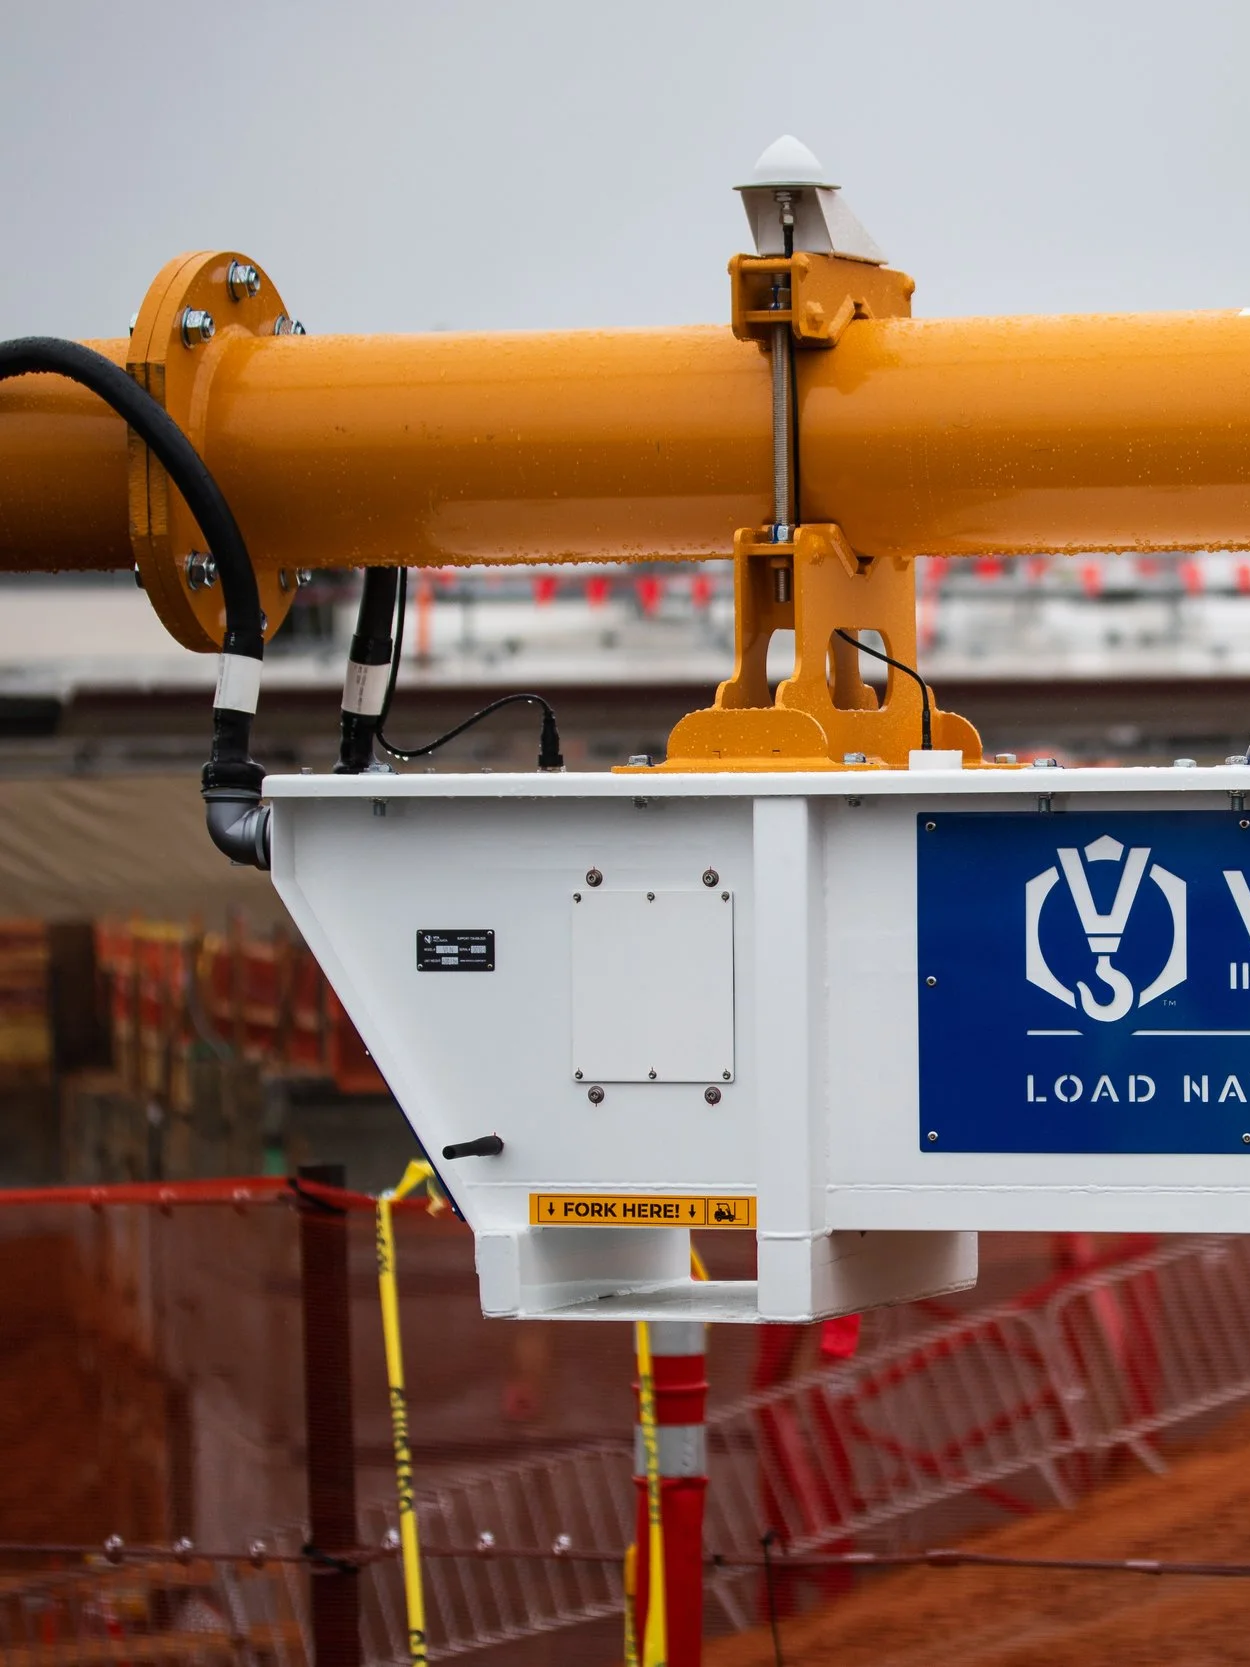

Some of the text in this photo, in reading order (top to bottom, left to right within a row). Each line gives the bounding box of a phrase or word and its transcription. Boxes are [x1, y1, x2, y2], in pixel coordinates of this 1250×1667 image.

[1027, 1074, 1156, 1103] LOAD
[563, 1202, 680, 1219] FORK HERE!
